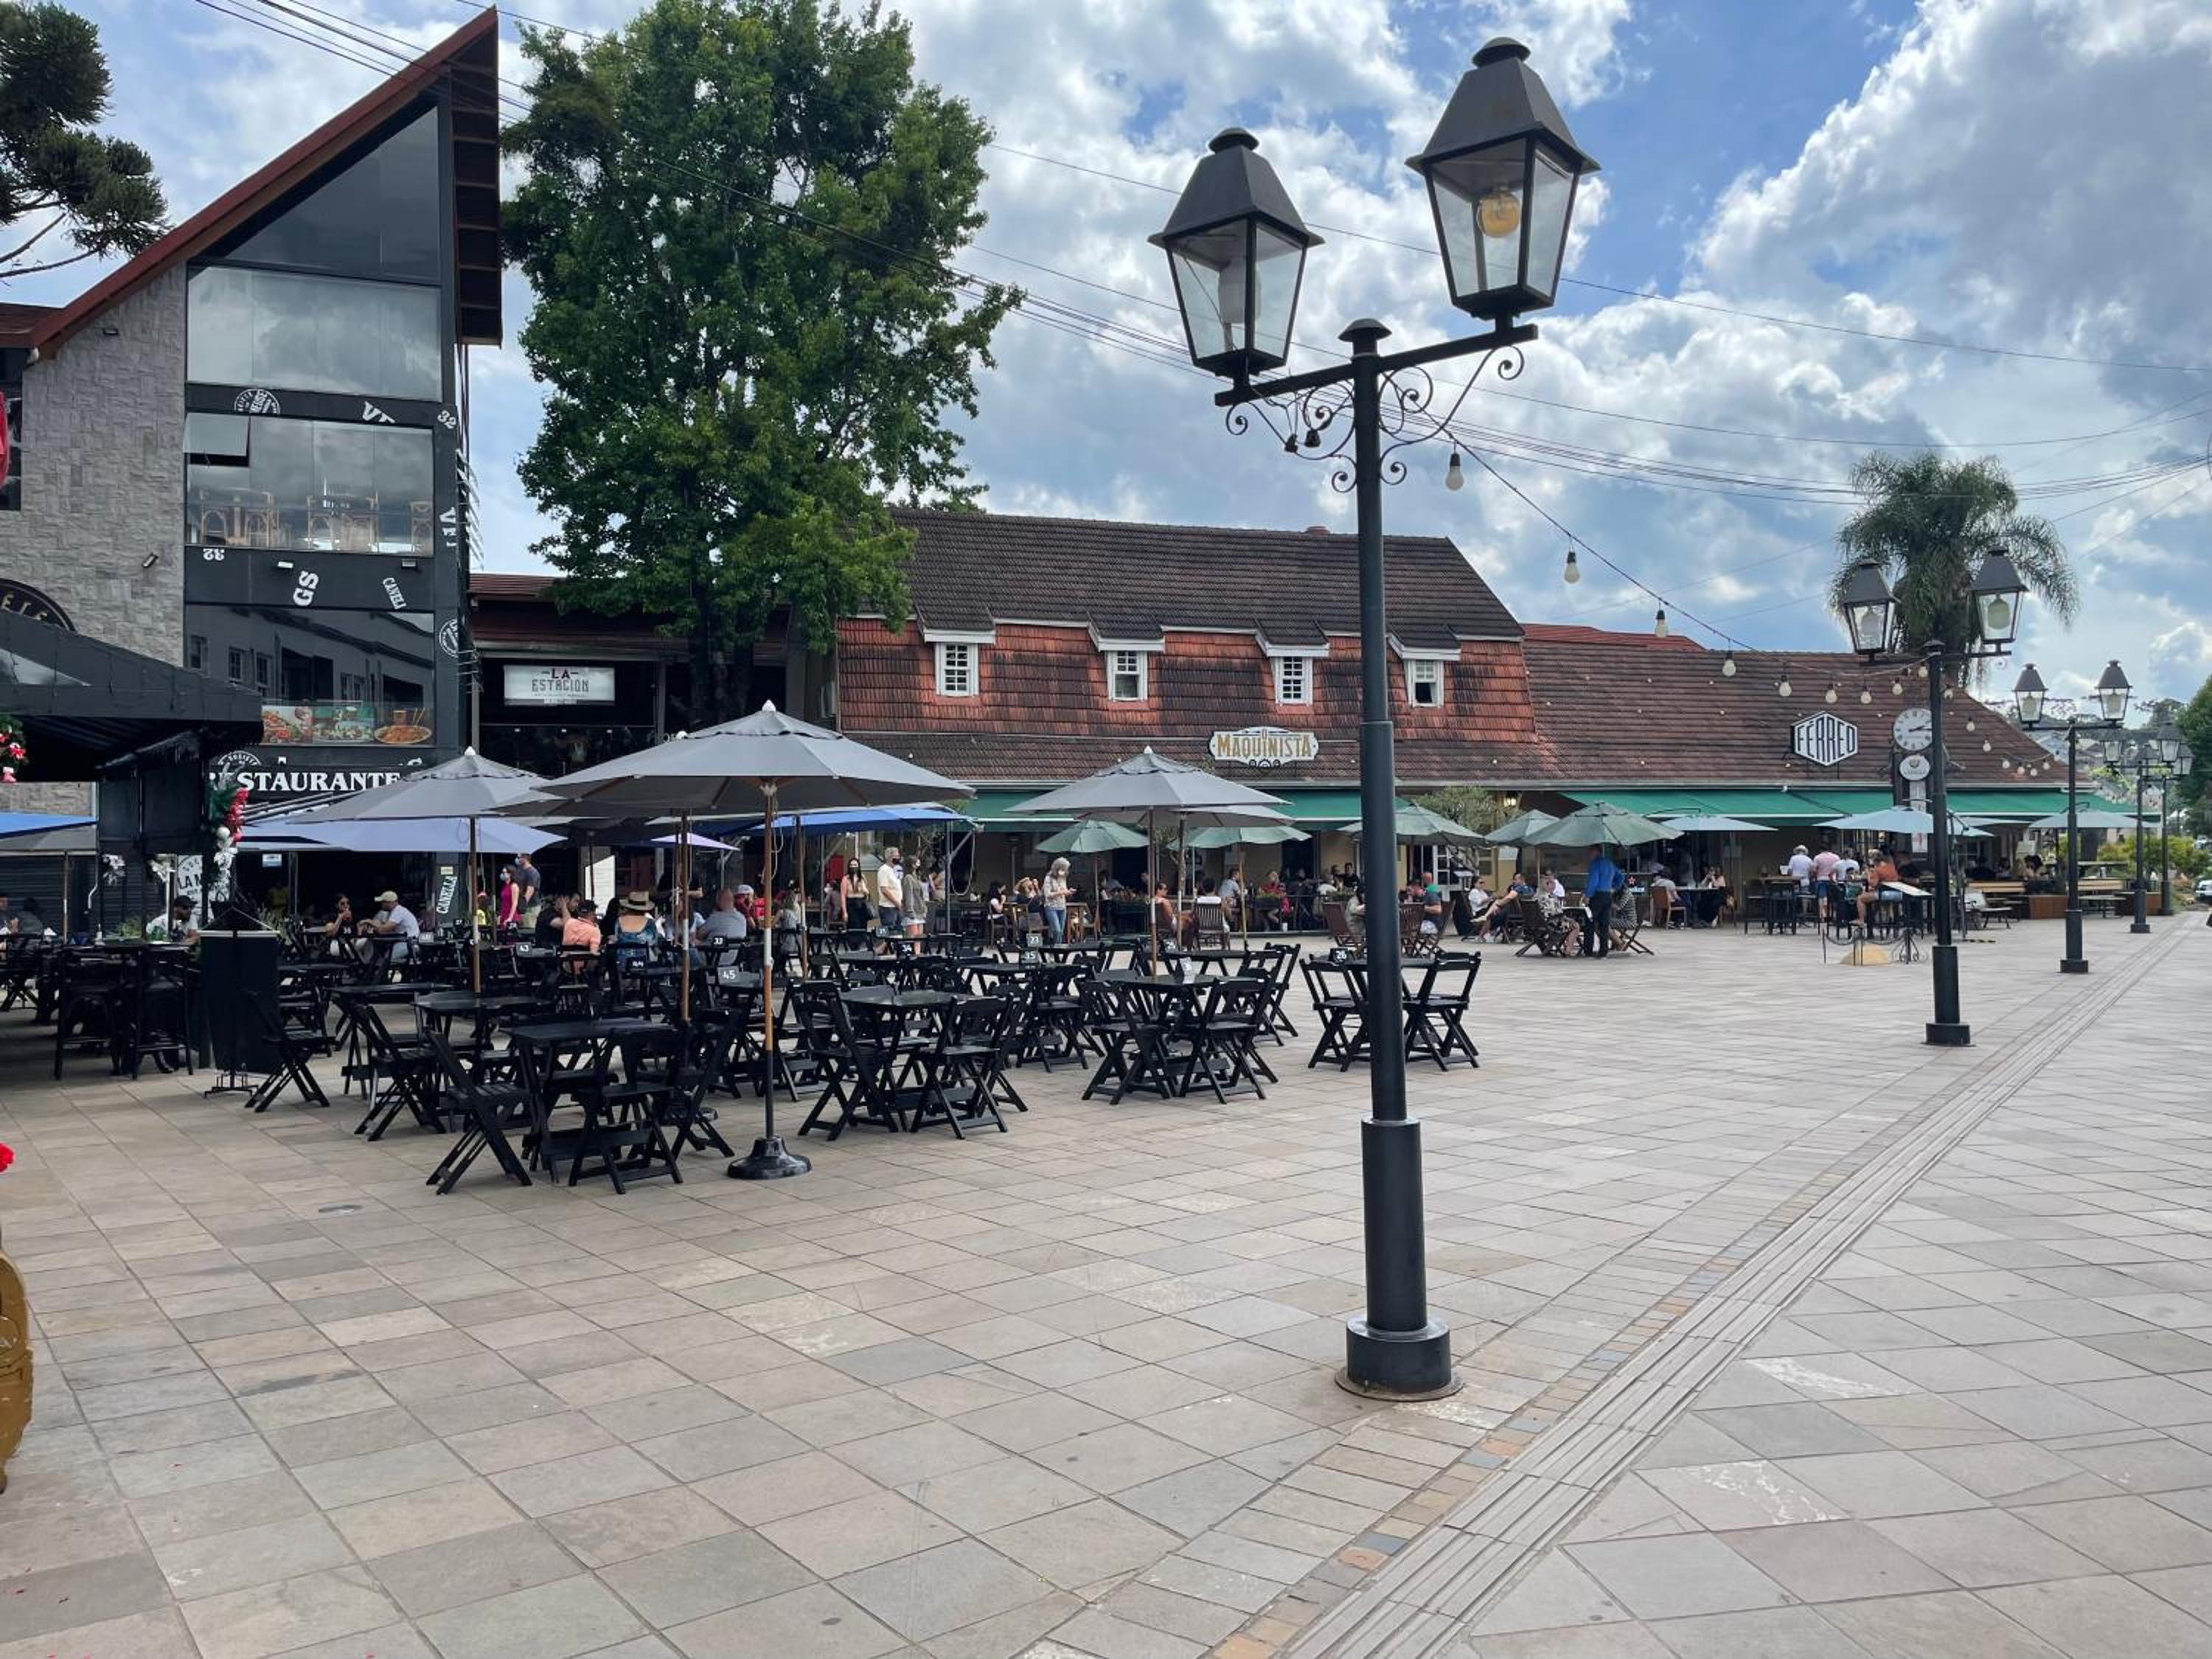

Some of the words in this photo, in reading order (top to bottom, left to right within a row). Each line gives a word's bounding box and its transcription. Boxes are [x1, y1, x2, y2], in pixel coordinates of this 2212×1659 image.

[437, 410, 456, 429] 32
[203, 548, 225, 561] 32
[293, 571, 319, 607] GS
[552, 668, 571, 679] LA
[532, 679, 589, 692] ESTACION
[1217, 733, 1312, 759] MAQUINISTA
[1335, 950, 1347, 959] 26
[723, 970, 736, 980] 45
